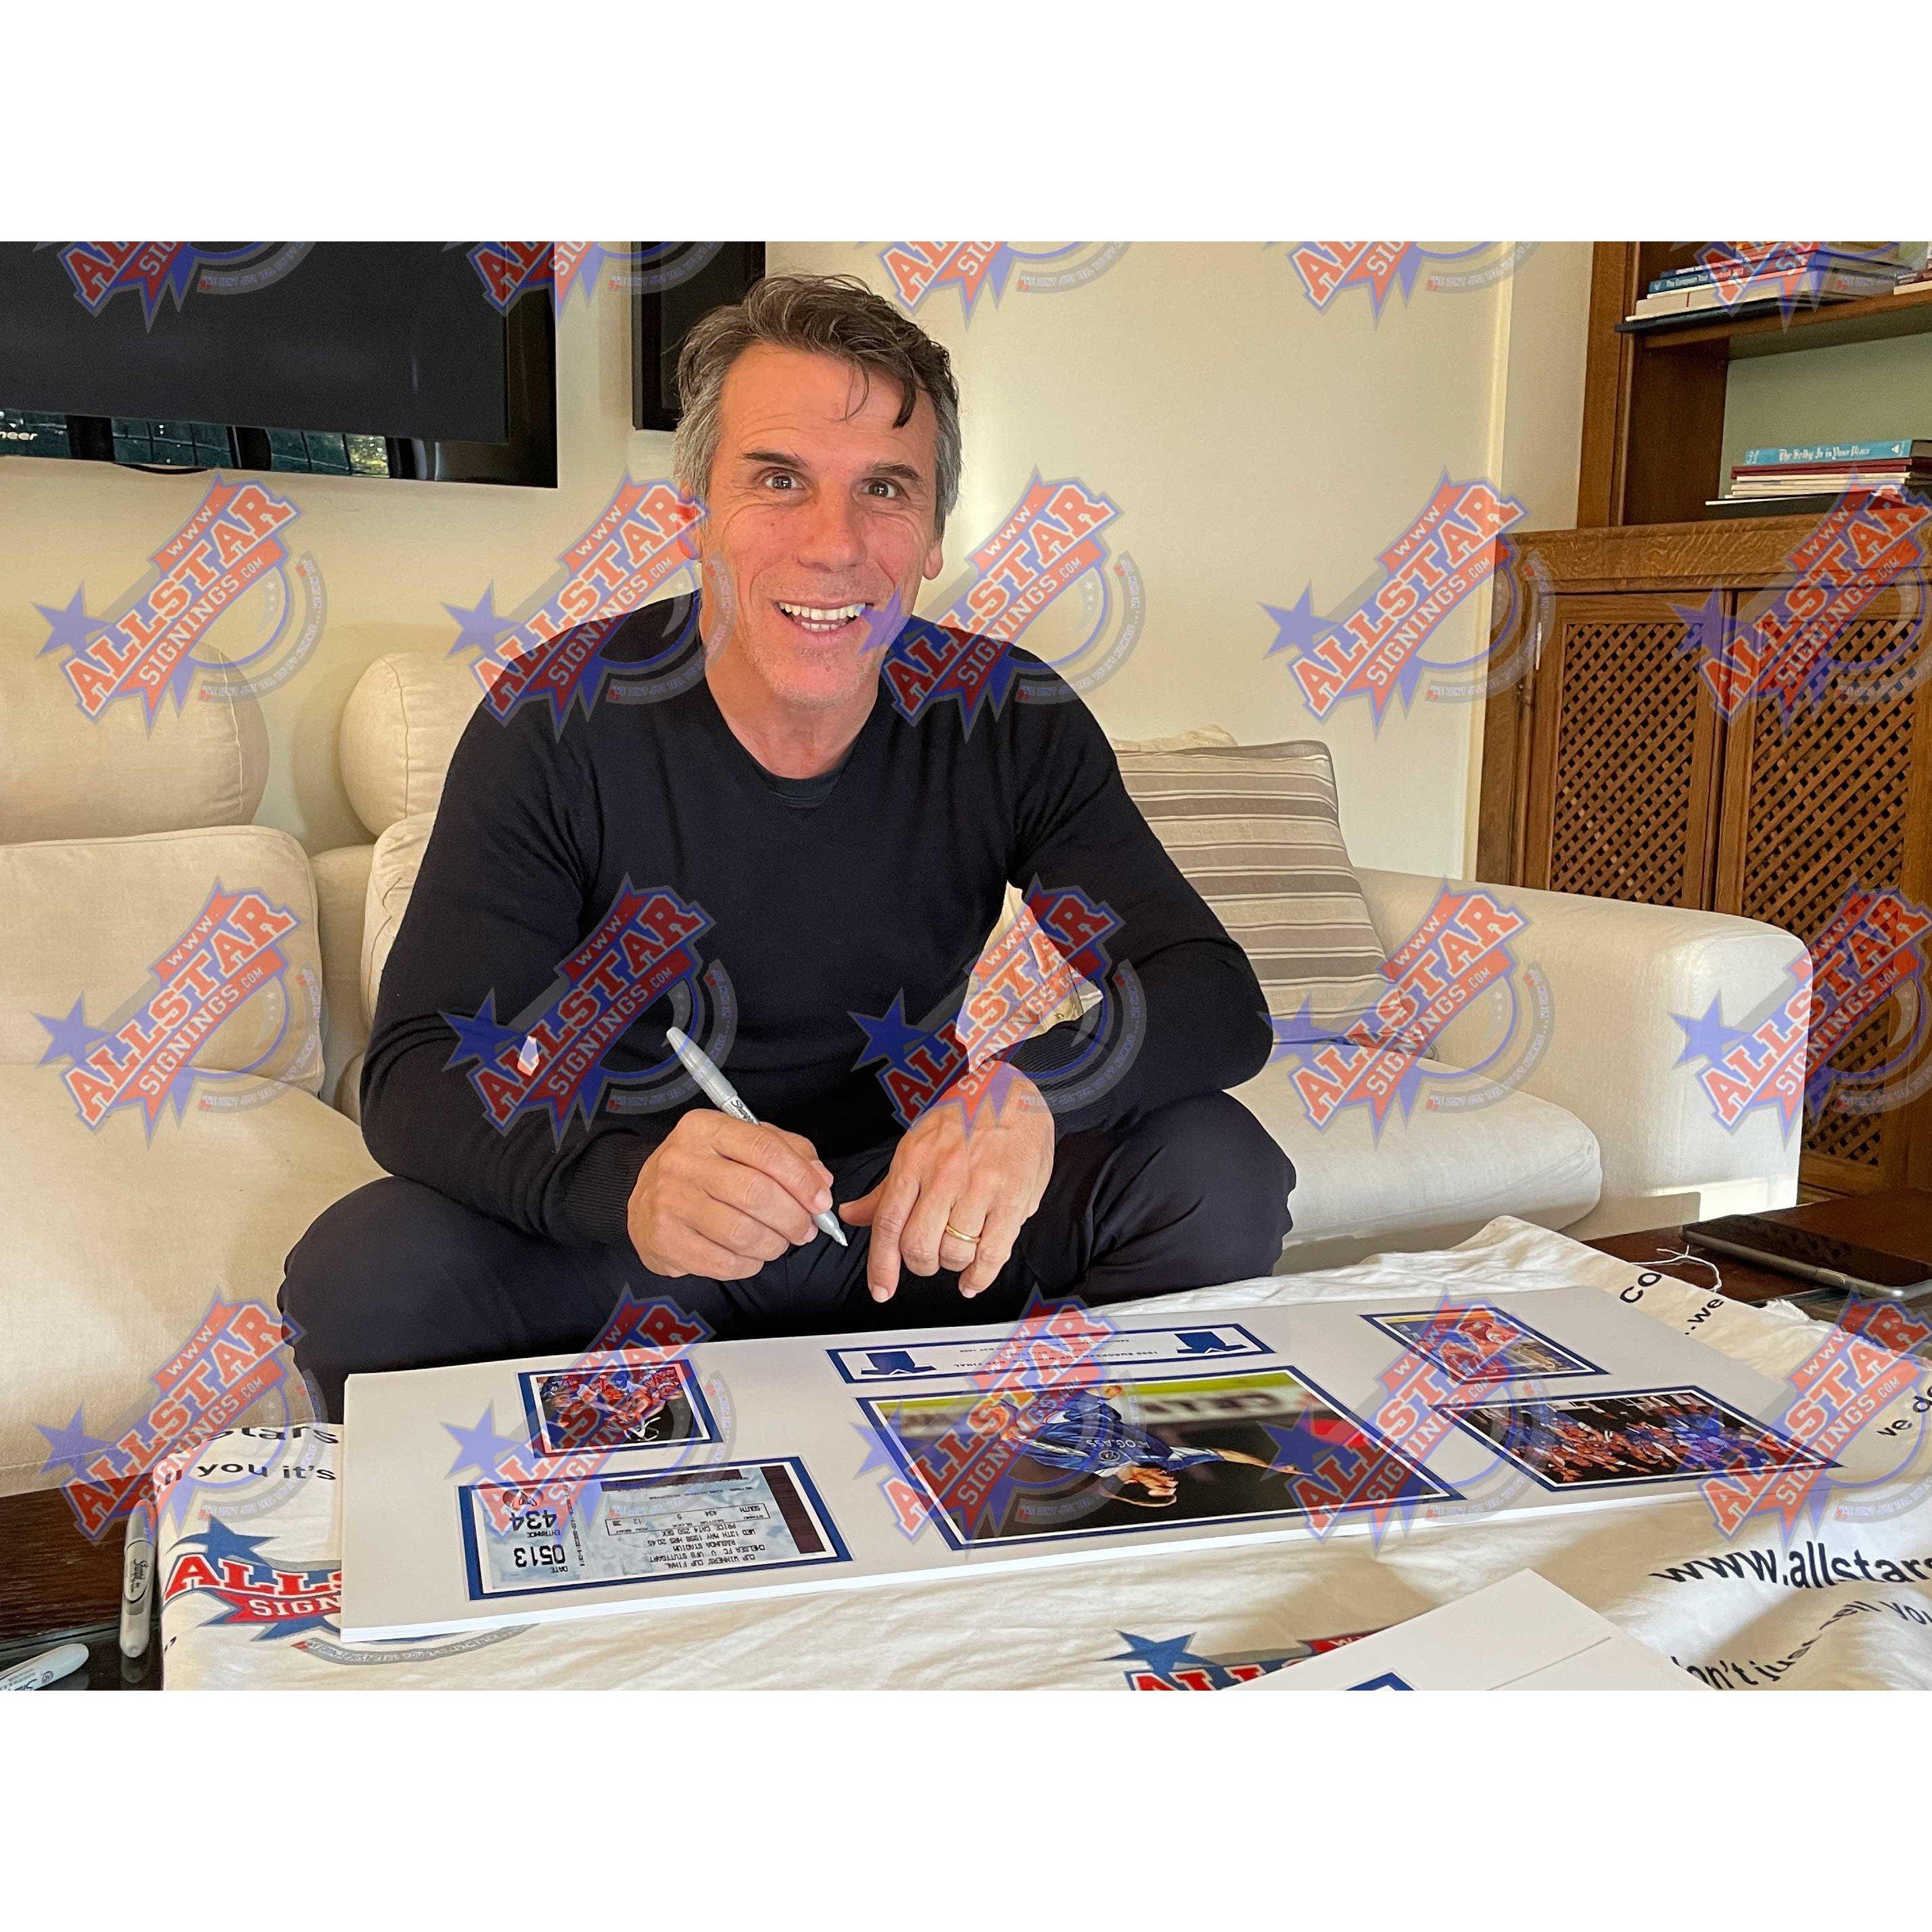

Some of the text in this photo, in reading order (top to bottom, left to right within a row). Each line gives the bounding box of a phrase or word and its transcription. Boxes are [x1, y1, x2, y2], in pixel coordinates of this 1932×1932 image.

[197, 1463, 268, 1478] you
[509, 1510, 557, 1532] 434
[715, 1522, 736, 1530] PRICE
[527, 1530, 560, 1538] ENTRANCE
[673, 1542, 703, 1551] STADIUM
[735, 1545, 765, 1554] CHELSEA
[513, 1545, 565, 1568] 0513
[649, 1553, 688, 1563] STUTTGART
[665, 1561, 687, 1569] FINAL
[690, 1559, 703, 1567] CUP
